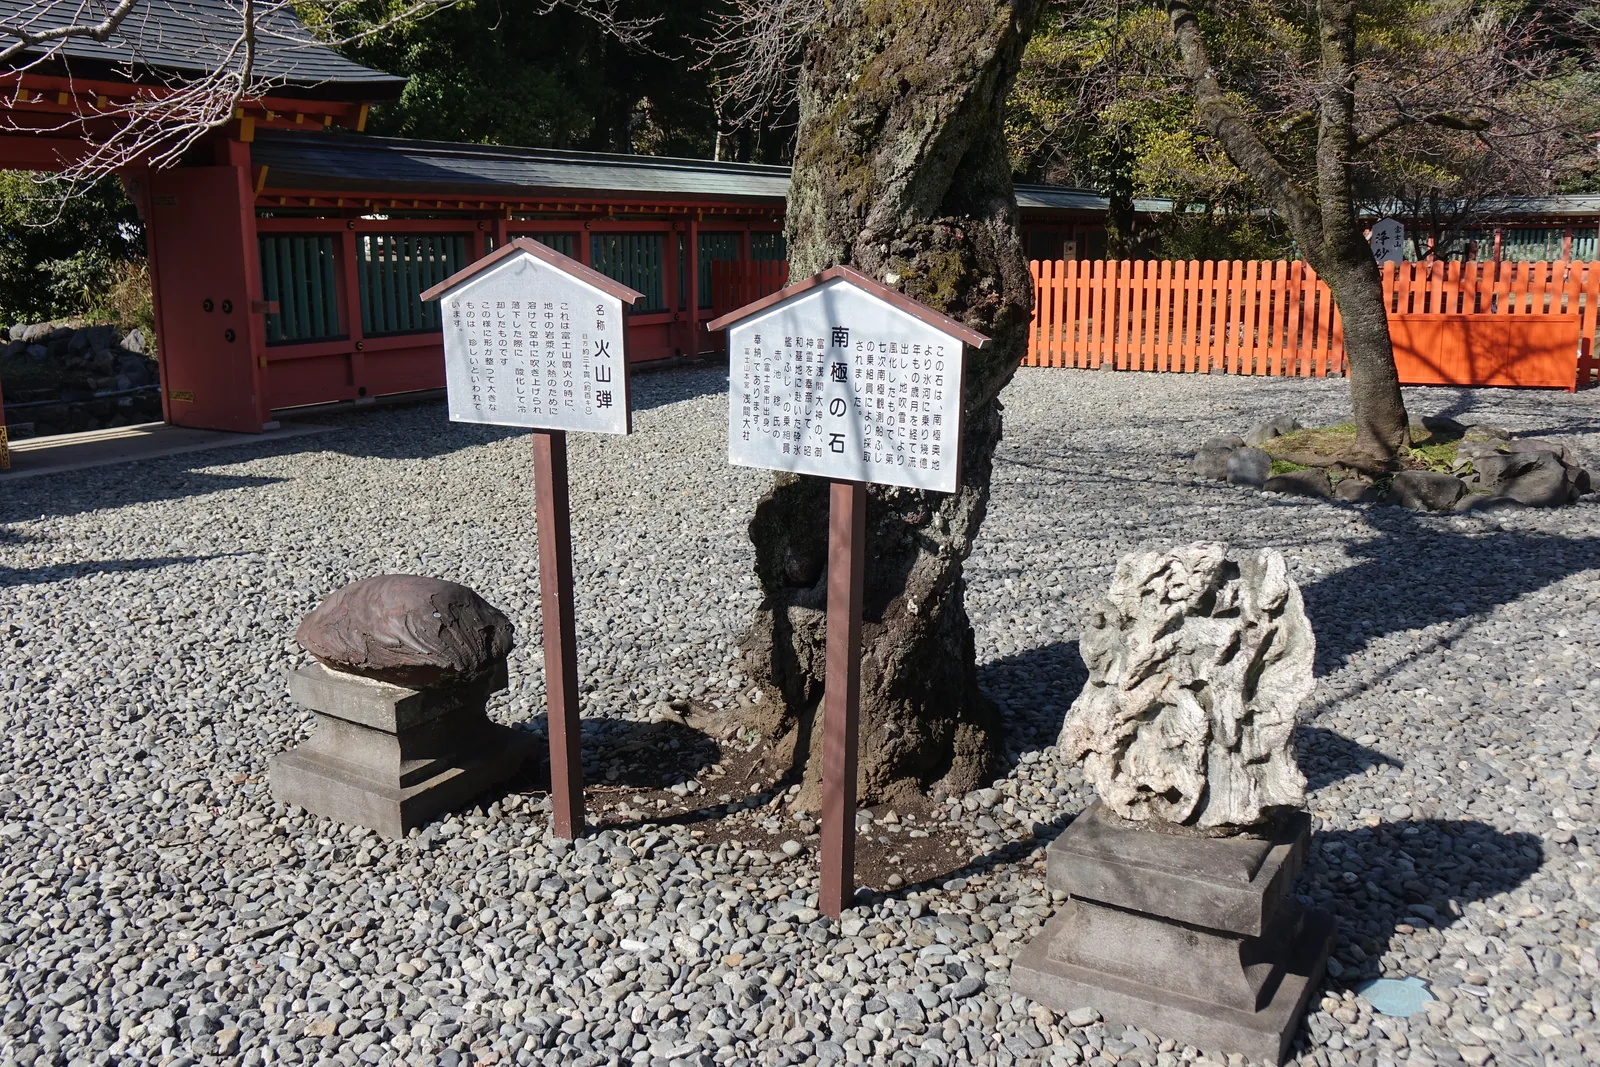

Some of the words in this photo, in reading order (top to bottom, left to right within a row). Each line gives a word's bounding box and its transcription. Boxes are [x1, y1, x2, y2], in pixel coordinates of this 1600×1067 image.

[452, 301, 463, 332] います。
[466, 301, 481, 411] ものは、珍しいといわれて
[481, 301, 497, 412] この様に形が整って大きな
[496, 301, 509, 366] 却したものです
[527, 301, 542, 415] 溶けて空中に吹き上げられ
[594, 339, 613, 409] 火山弾
[828, 325, 850, 454] 南極の石
[853, 340, 864, 416] されました。
[896, 342, 908, 467] 出し、地吹雪により
